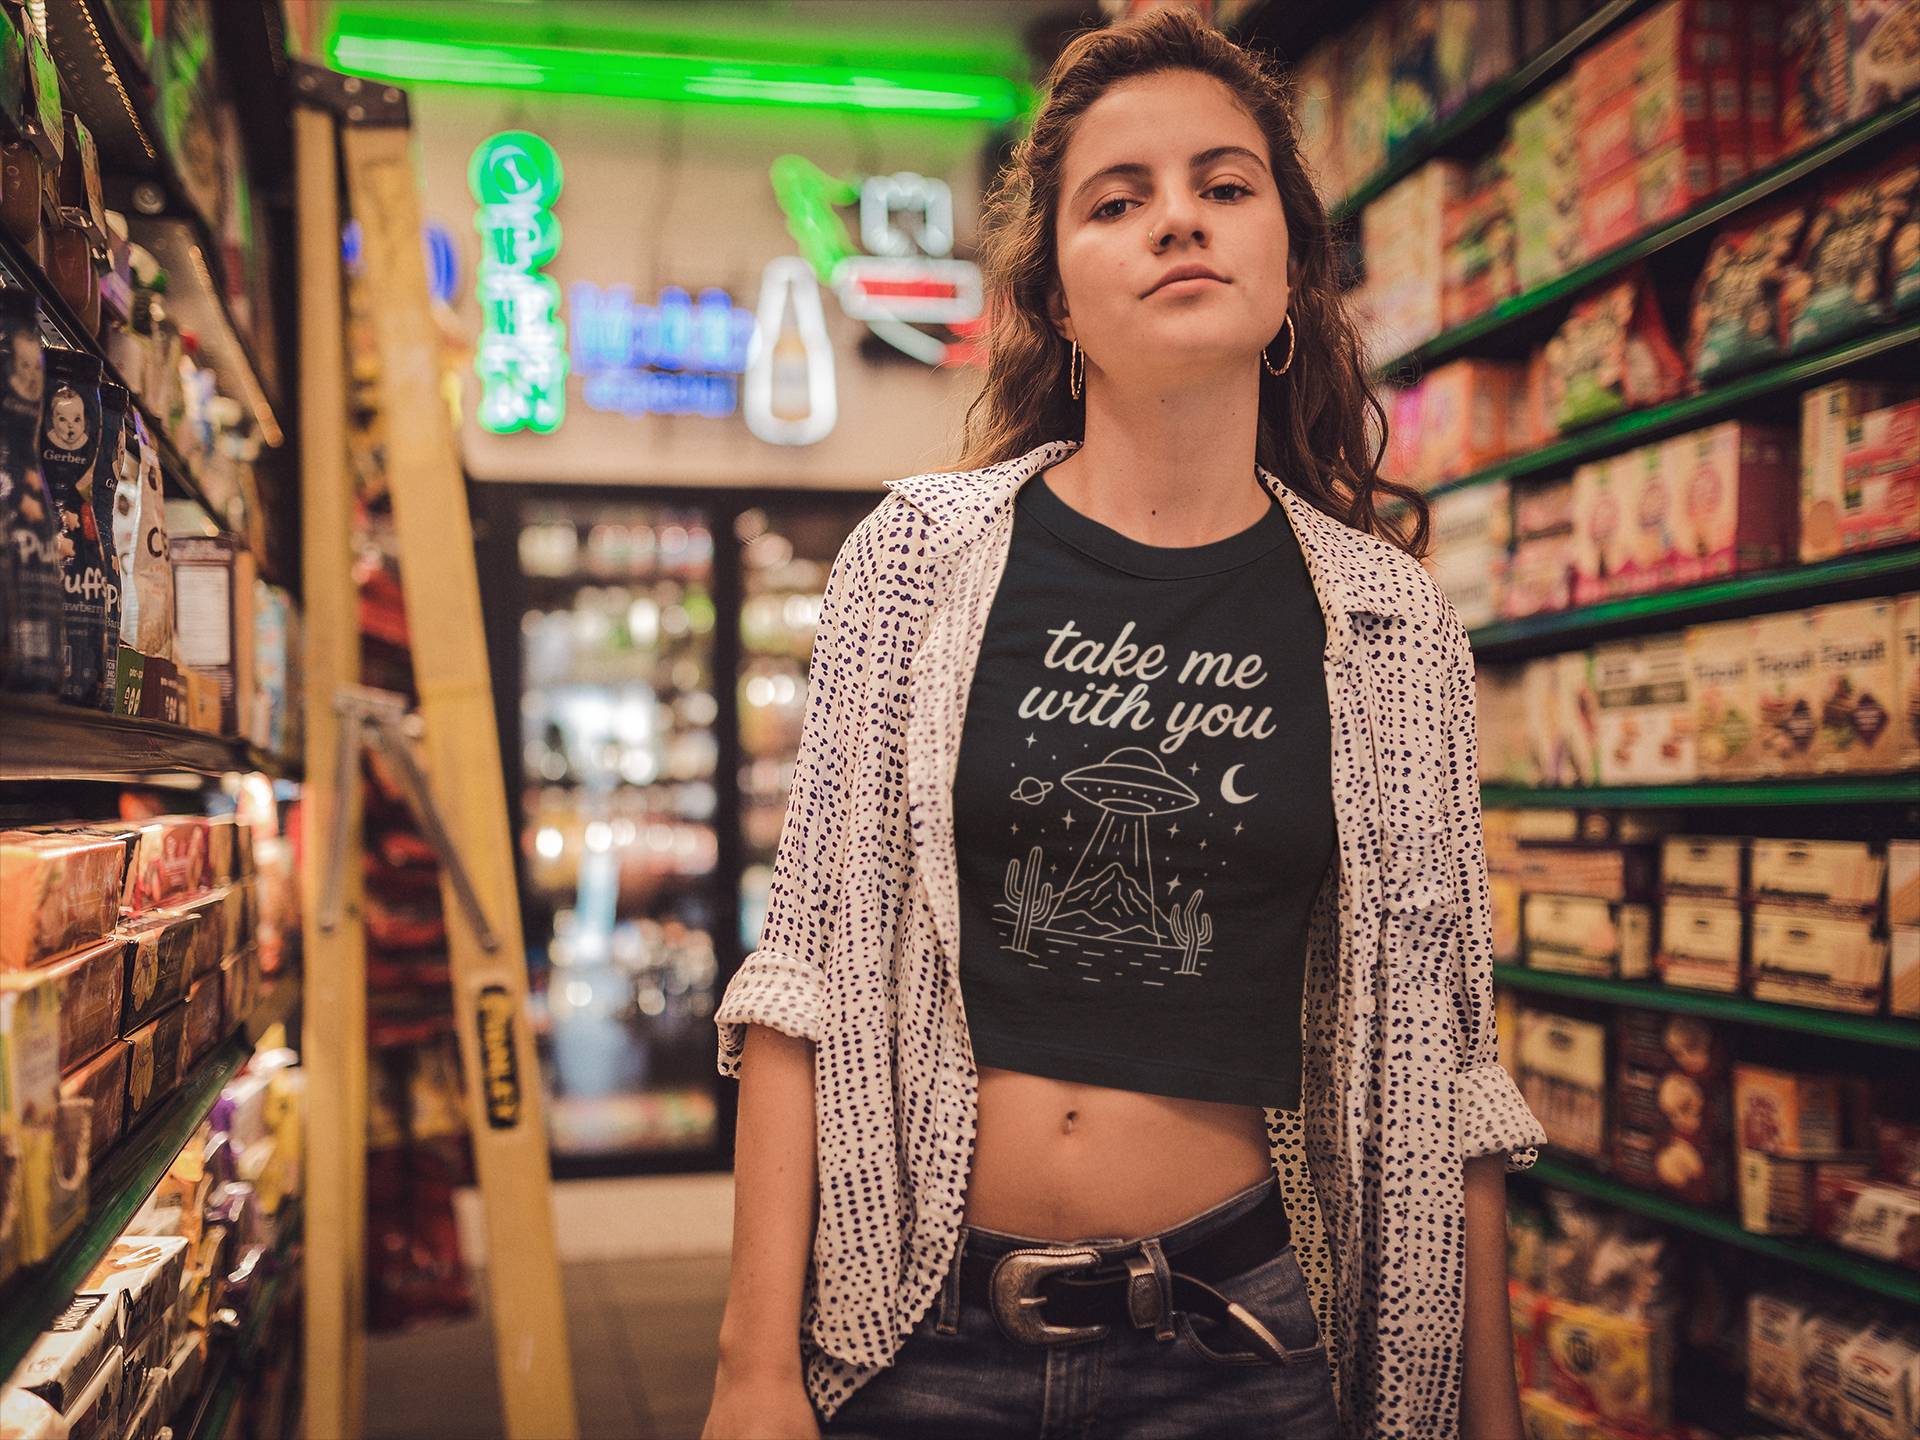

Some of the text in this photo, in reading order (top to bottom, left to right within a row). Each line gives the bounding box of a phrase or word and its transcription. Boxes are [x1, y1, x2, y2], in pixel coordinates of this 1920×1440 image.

[43, 449, 87, 465] Gerber
[60, 566, 107, 601] uffs
[1043, 619, 1269, 690] take me
[1017, 682, 1277, 755] with you
